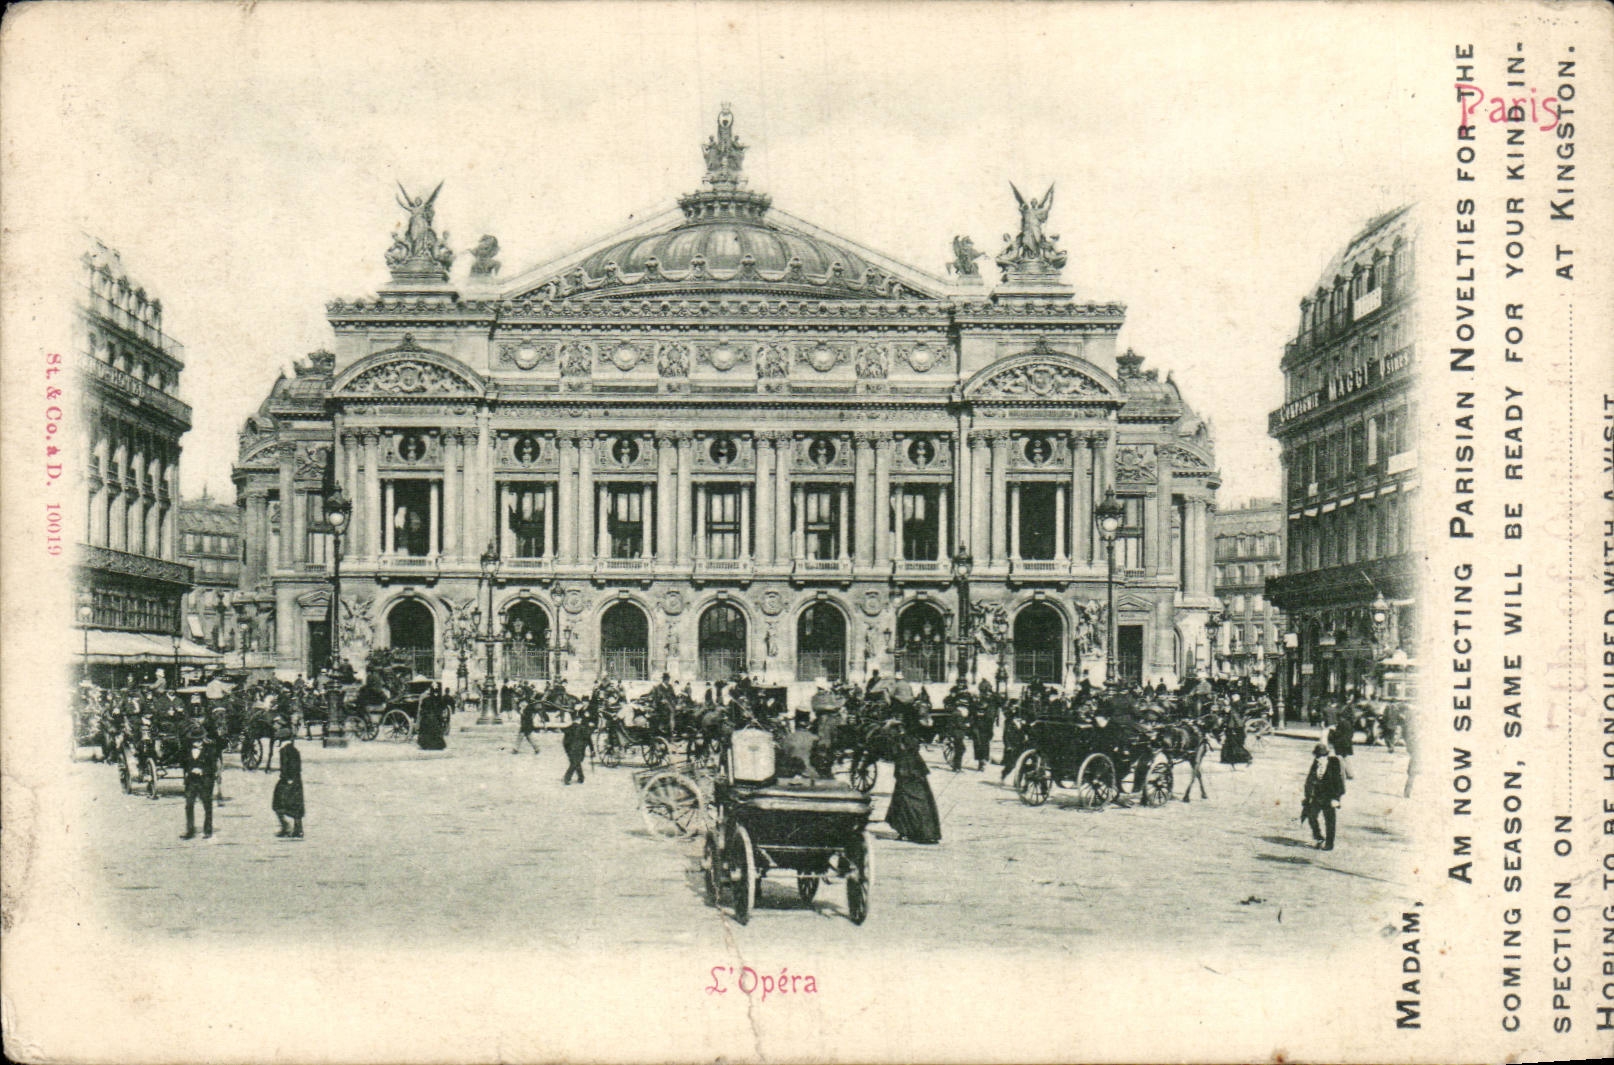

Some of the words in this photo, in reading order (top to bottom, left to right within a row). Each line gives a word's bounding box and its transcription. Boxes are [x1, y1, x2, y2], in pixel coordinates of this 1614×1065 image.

[1455, 44, 1475, 102] THE
[1507, 42, 1525, 86] IN-
[1457, 125, 1476, 181] FOR
[1507, 105, 1525, 180] KIND
[1551, 46, 1576, 220] KINGSTON.
[1505, 198, 1524, 278] YOUR
[1556, 244, 1574, 280] AT
[1450, 199, 1475, 372] NOVELTIES
[1505, 303, 1523, 362] FOR
[1328, 360, 1369, 402] MAGGI
[1449, 392, 1474, 538] PARISIAN
[1504, 387, 1523, 480] READY
[1504, 503, 1523, 540] BE
[1504, 564, 1522, 635] WILL
[1453, 564, 1473, 731] SELECTING
[1503, 655, 1522, 738] SAME
[1453, 747, 1472, 815] NOW
[1603, 799, 1614, 835] BE
[1448, 836, 1473, 884] AM
[1503, 761, 1525, 892] SEASON,
[1553, 816, 1573, 857] ON
[1603, 853, 1614, 890] TO
[1396, 901, 1422, 1029] MADAM,
[1502, 908, 1522, 1032] COMING
[1553, 882, 1572, 1033] SPECTION
[1597, 905, 1614, 1031] HOPING
